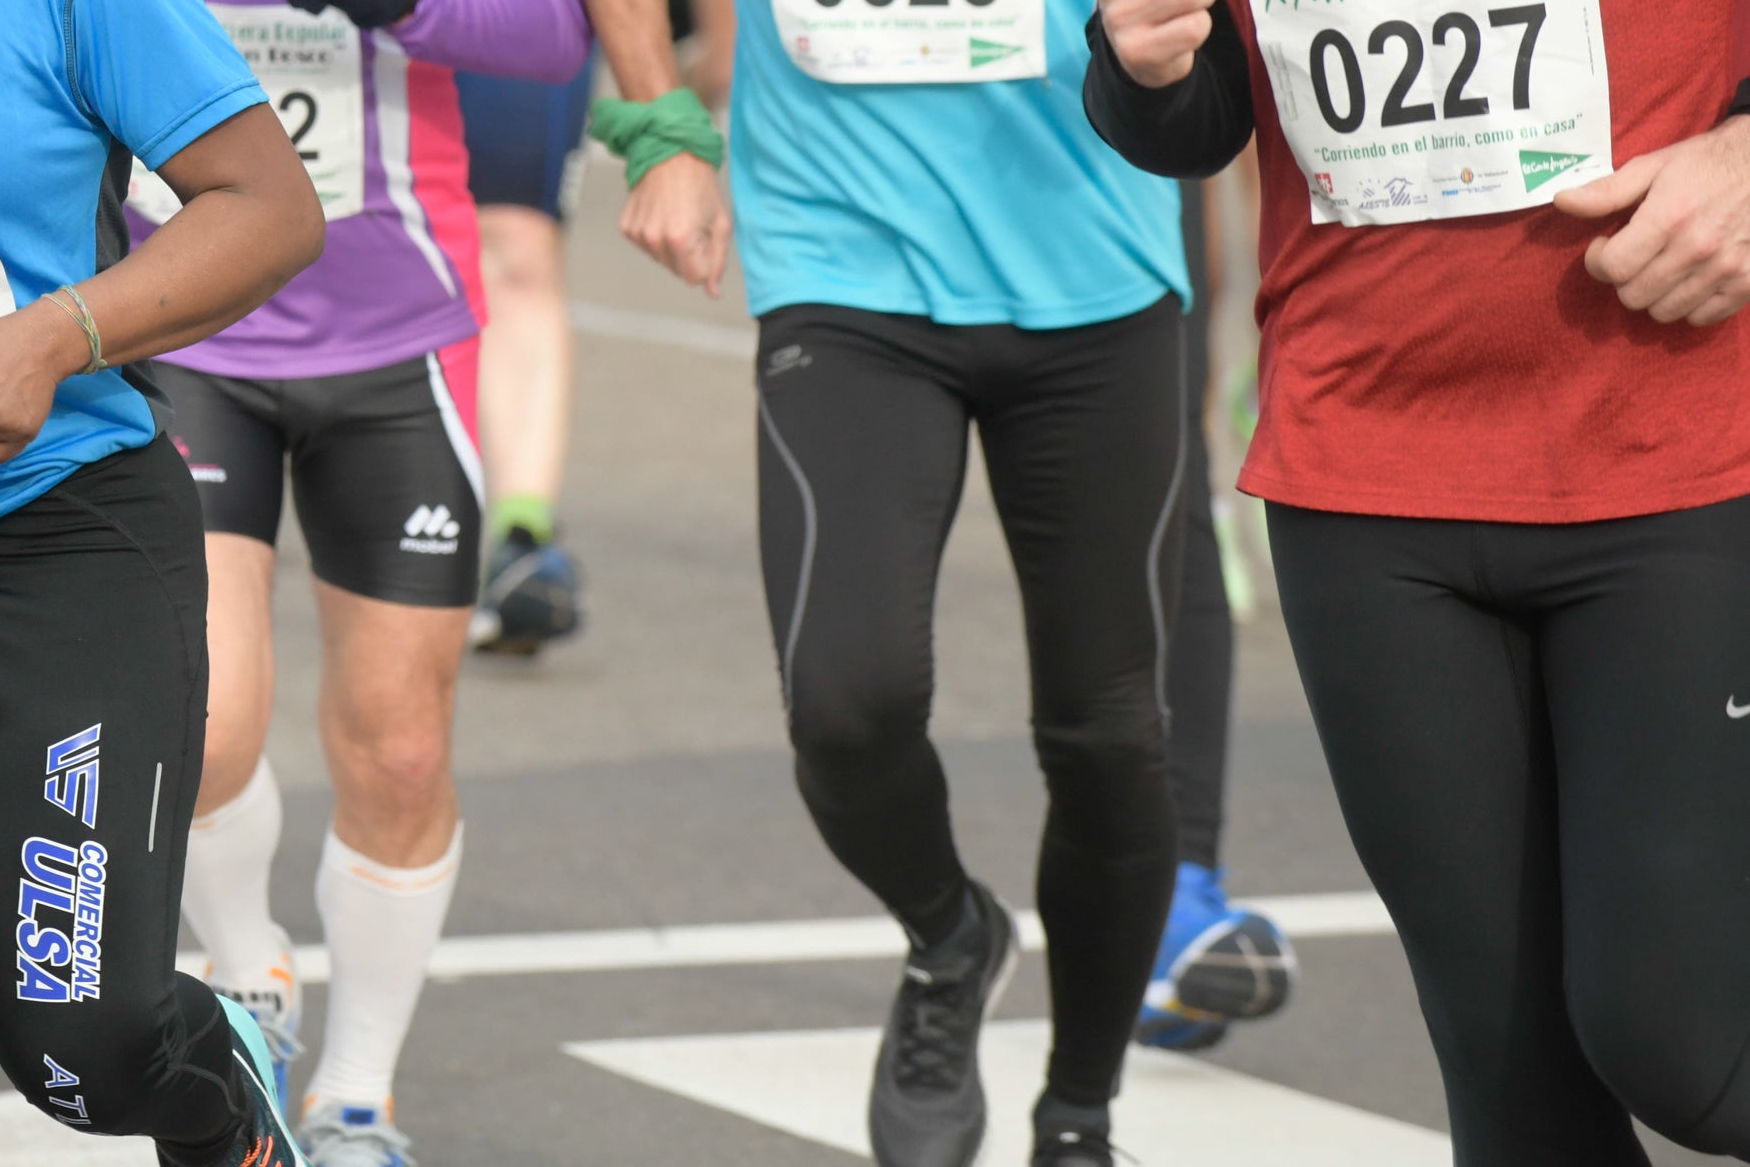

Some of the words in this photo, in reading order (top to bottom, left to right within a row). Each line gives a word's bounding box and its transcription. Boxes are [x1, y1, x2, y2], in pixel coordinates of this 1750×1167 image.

[1309, 2, 1547, 134] 0227
[1314, 142, 1386, 163] "Corriendo
[1392, 142, 1409, 155] en
[1414, 135, 1428, 152] el
[1432, 132, 1471, 151] barrio,
[1474, 129, 1514, 145] como
[1520, 126, 1538, 140] en
[1544, 114, 1583, 136] casa"
[16, 836, 79, 1003] ULSA
[71, 840, 108, 1002] COMERCIAL
